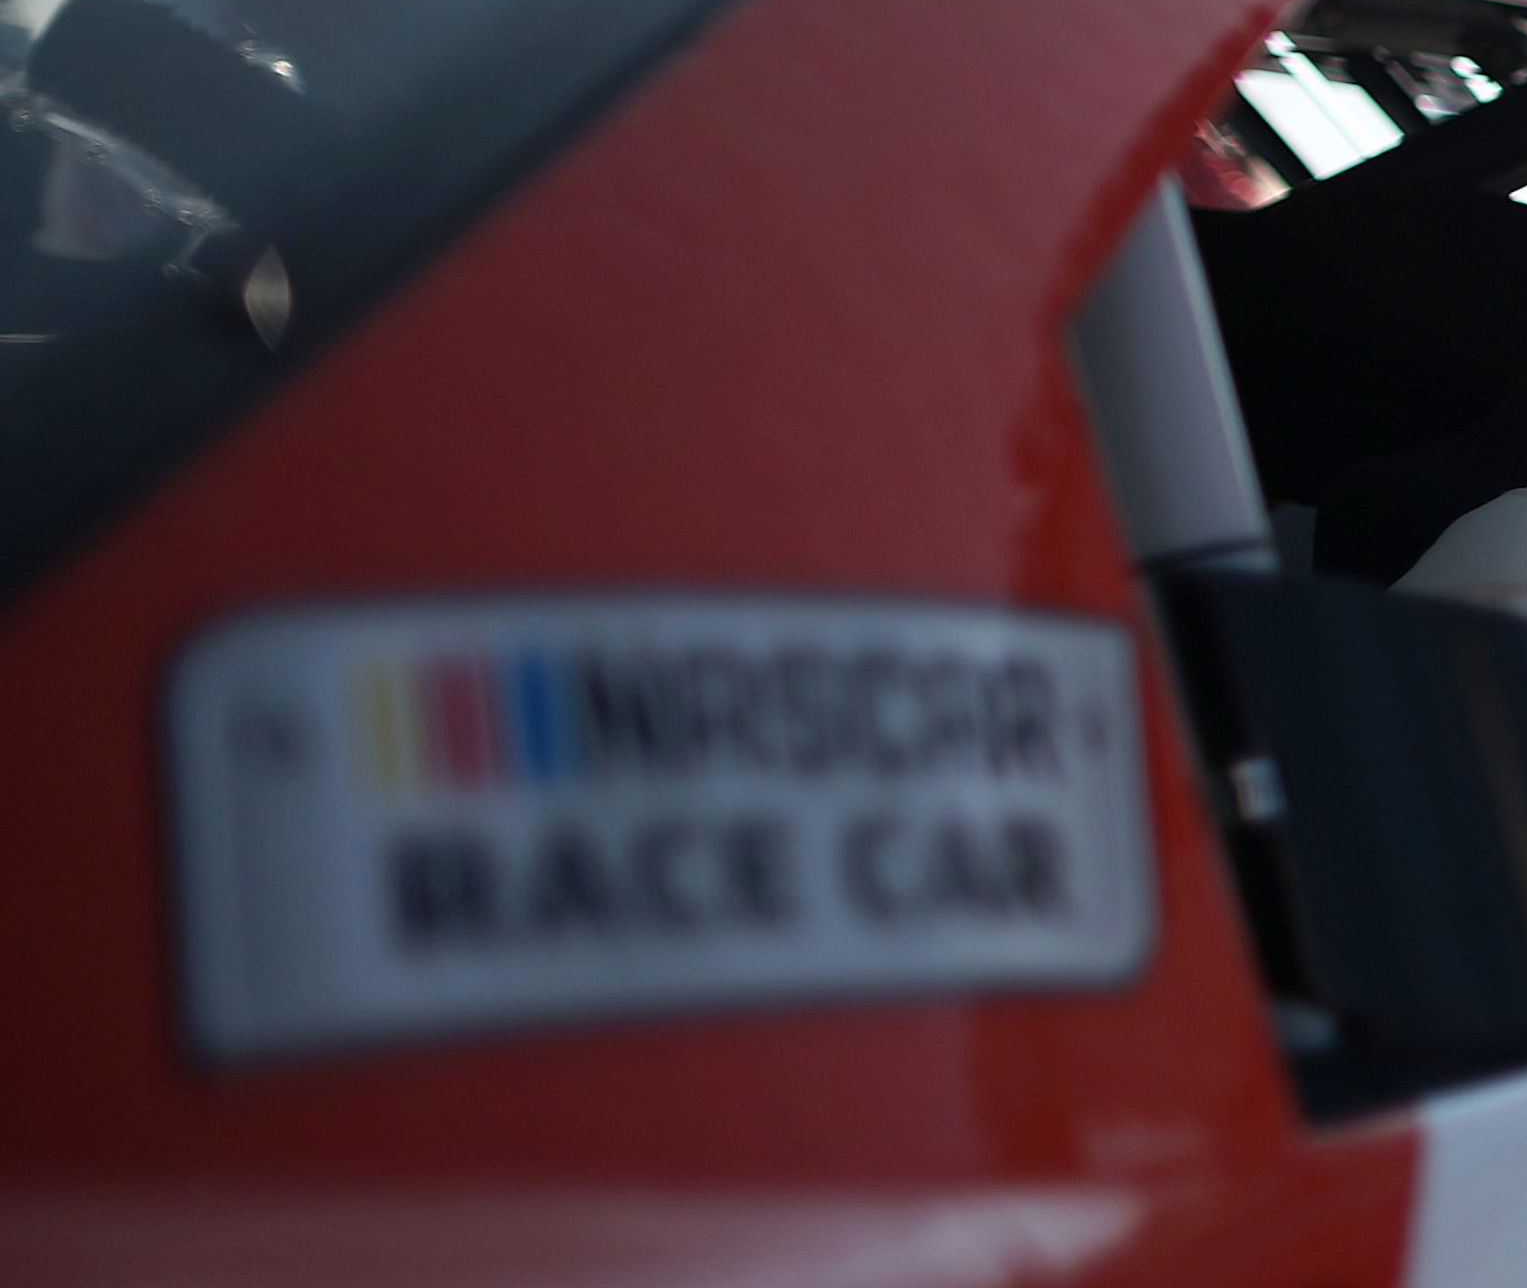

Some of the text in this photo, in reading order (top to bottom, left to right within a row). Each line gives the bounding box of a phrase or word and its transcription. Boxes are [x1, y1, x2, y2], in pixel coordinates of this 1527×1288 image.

[587, 642, 1065, 784] NASCAR
[385, 812, 1068, 960] RACE CAR
